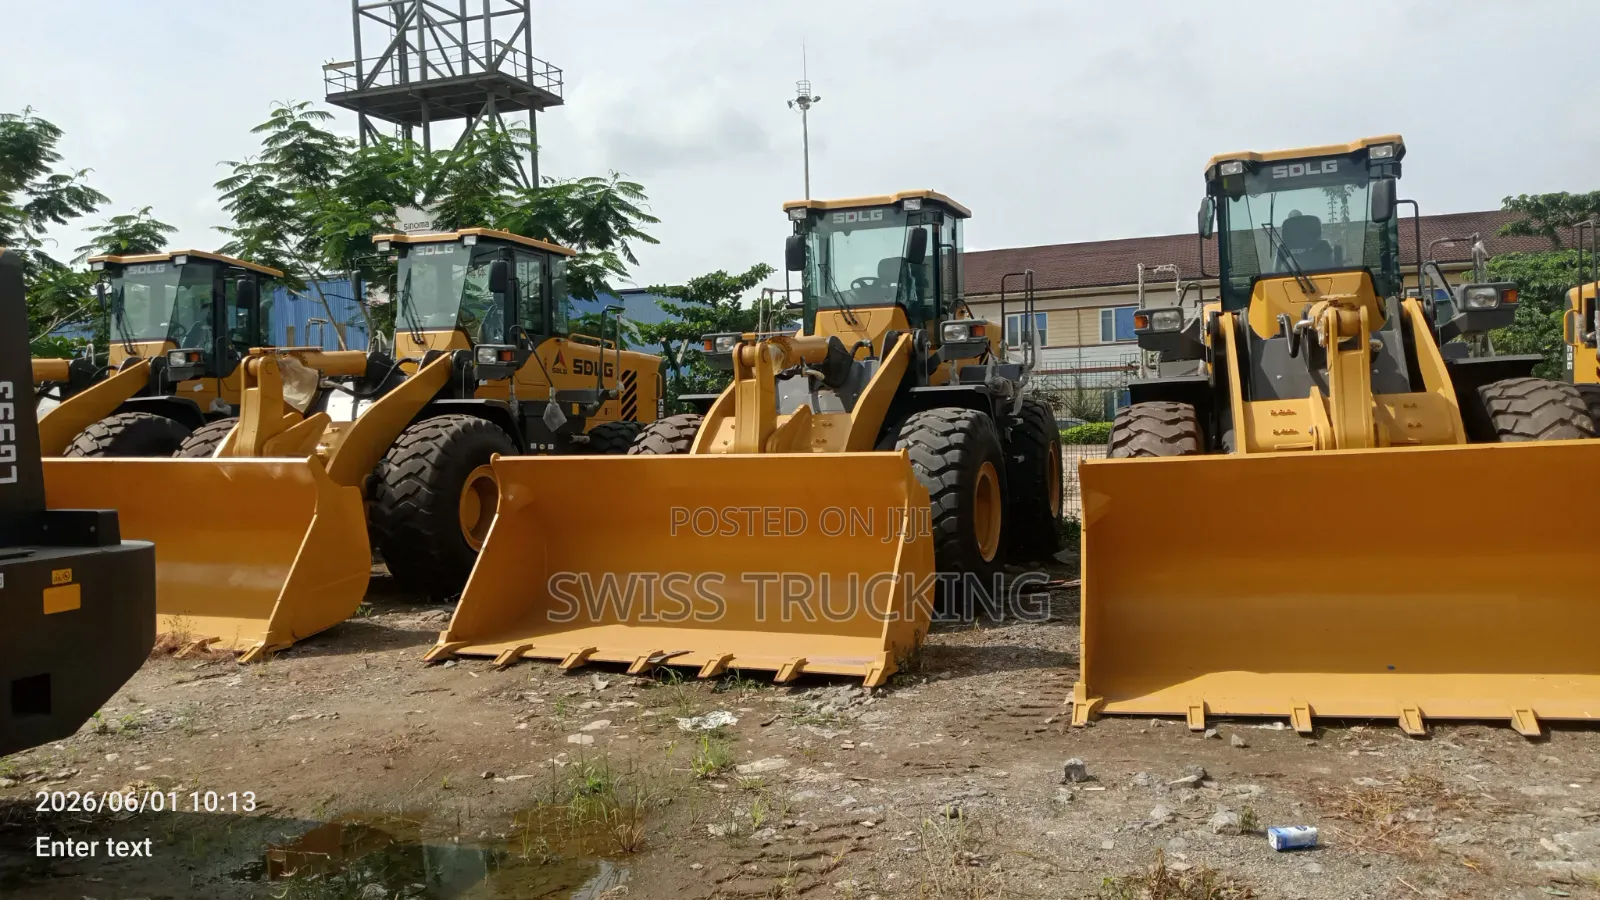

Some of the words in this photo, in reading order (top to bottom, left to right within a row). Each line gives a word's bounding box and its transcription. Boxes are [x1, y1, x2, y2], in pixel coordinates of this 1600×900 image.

[1272, 160, 1338, 178] SDLG
[833, 209, 883, 223] SDLG
[403, 221, 430, 230] sinoma
[416, 244, 455, 256] SDLG
[127, 263, 166, 275] SDLG
[573, 358, 613, 378] SDLG
